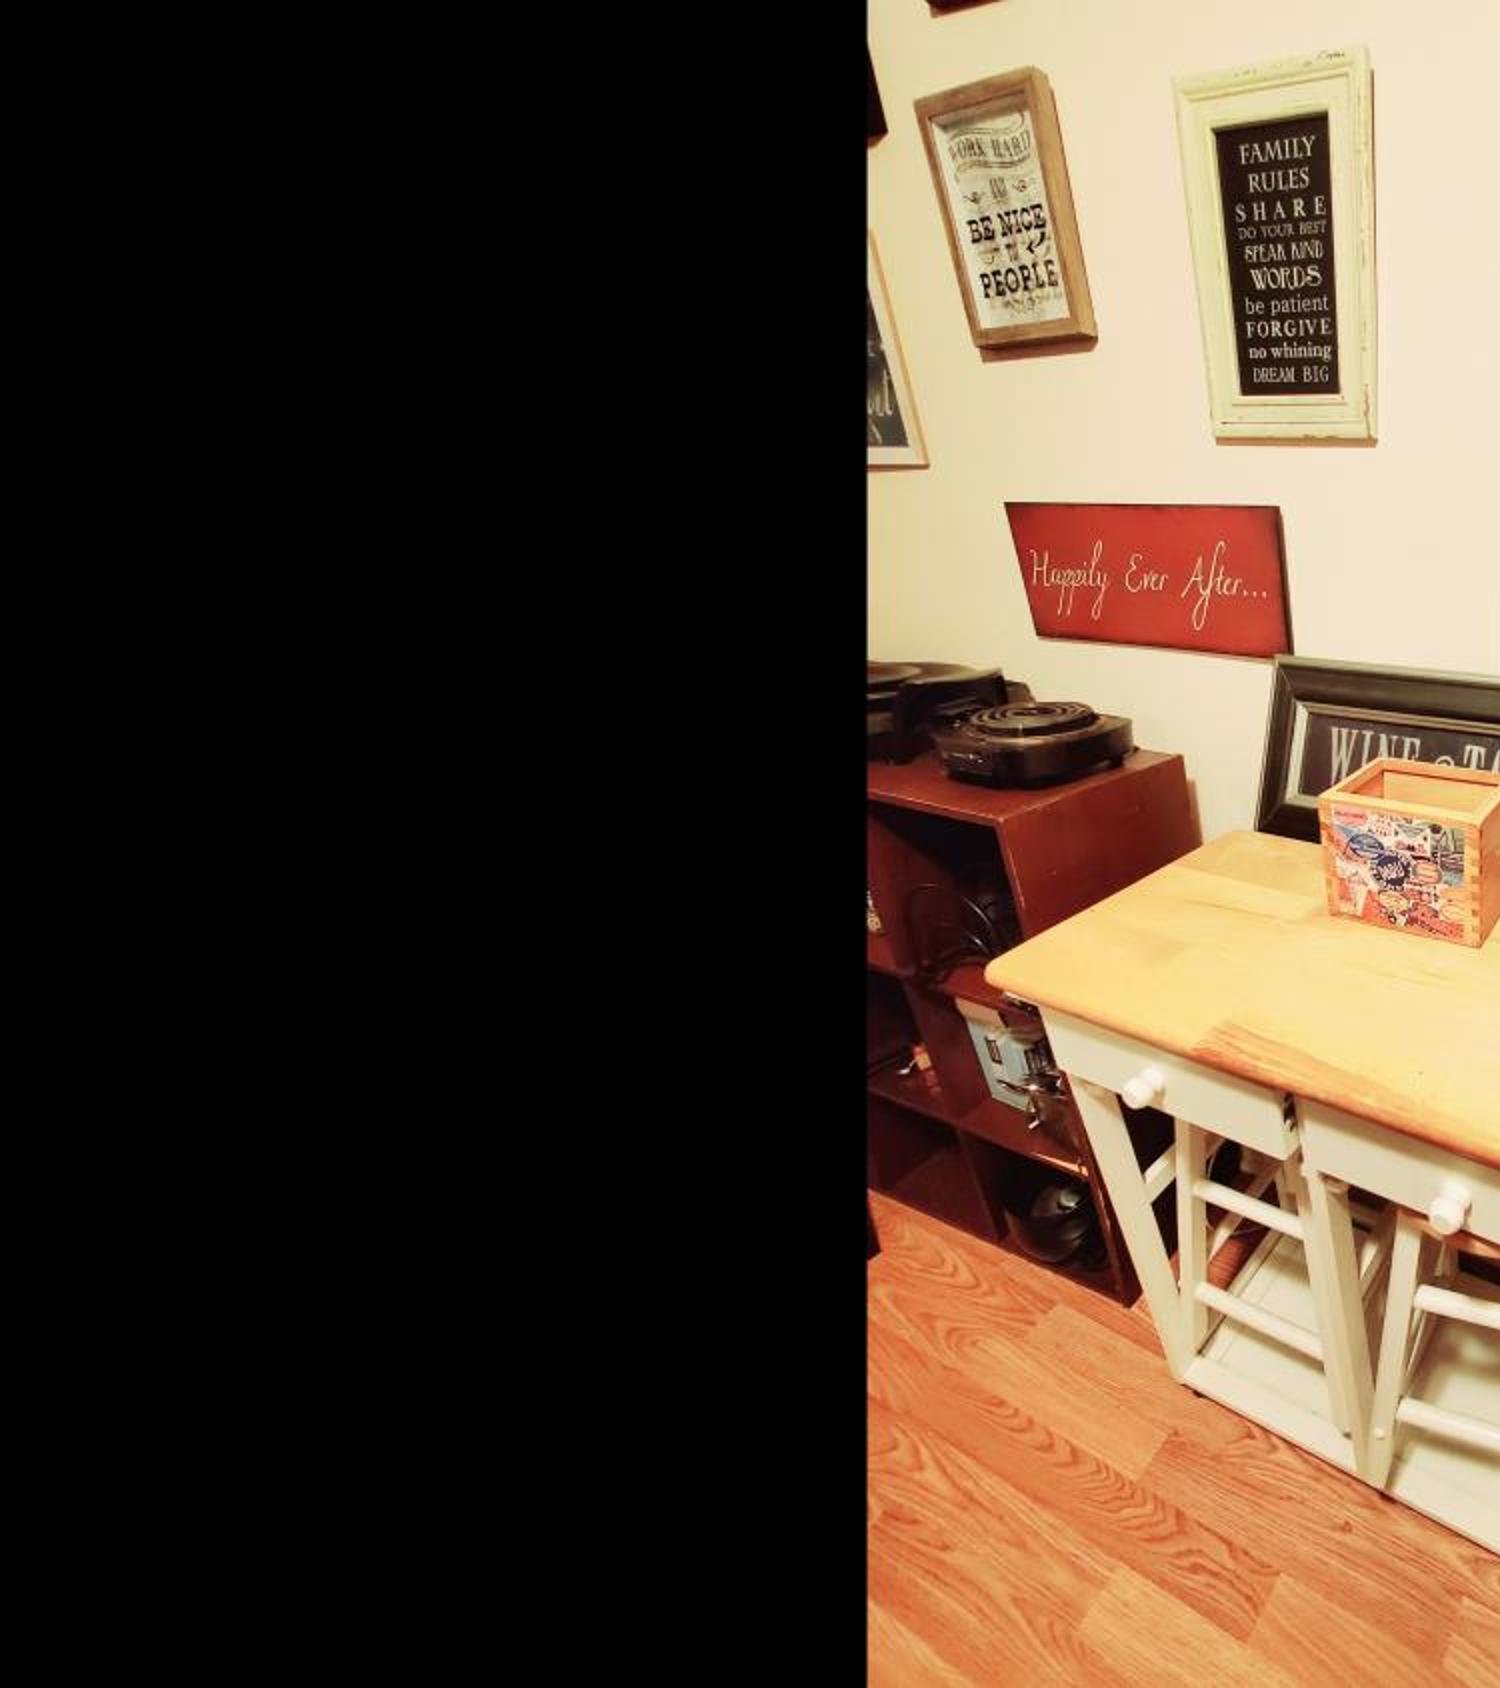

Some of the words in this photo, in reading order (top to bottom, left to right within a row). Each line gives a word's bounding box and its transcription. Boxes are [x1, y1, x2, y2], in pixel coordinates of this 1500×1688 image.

[1238, 135, 1316, 165] FAMILY
[1248, 166, 1310, 193] RULES
[1235, 195, 1327, 223] SHARE
[966, 215, 995, 244] BE
[997, 203, 1047, 237] NICE
[1238, 227, 1257, 240] DO
[1260, 223, 1294, 238] YOUR
[1299, 220, 1327, 235] BEST
[1245, 242, 1287, 263] SPEAK
[1291, 239, 1324, 261] KIND
[980, 259, 1059, 298] PEOPLE
[1250, 264, 1322, 291] WORDS
[1245, 297, 1265, 315] be
[1271, 293, 1329, 317] patient
[1245, 318, 1332, 338] FORGIVE
[1249, 347, 1267, 359] no
[1271, 341, 1331, 363] whining
[1253, 366, 1295, 383] DREAM
[1303, 365, 1329, 382] BIG
[1029, 539, 1111, 620] Happily
[1124, 553, 1169, 593] Ever
[1181, 540, 1267, 631] After...
